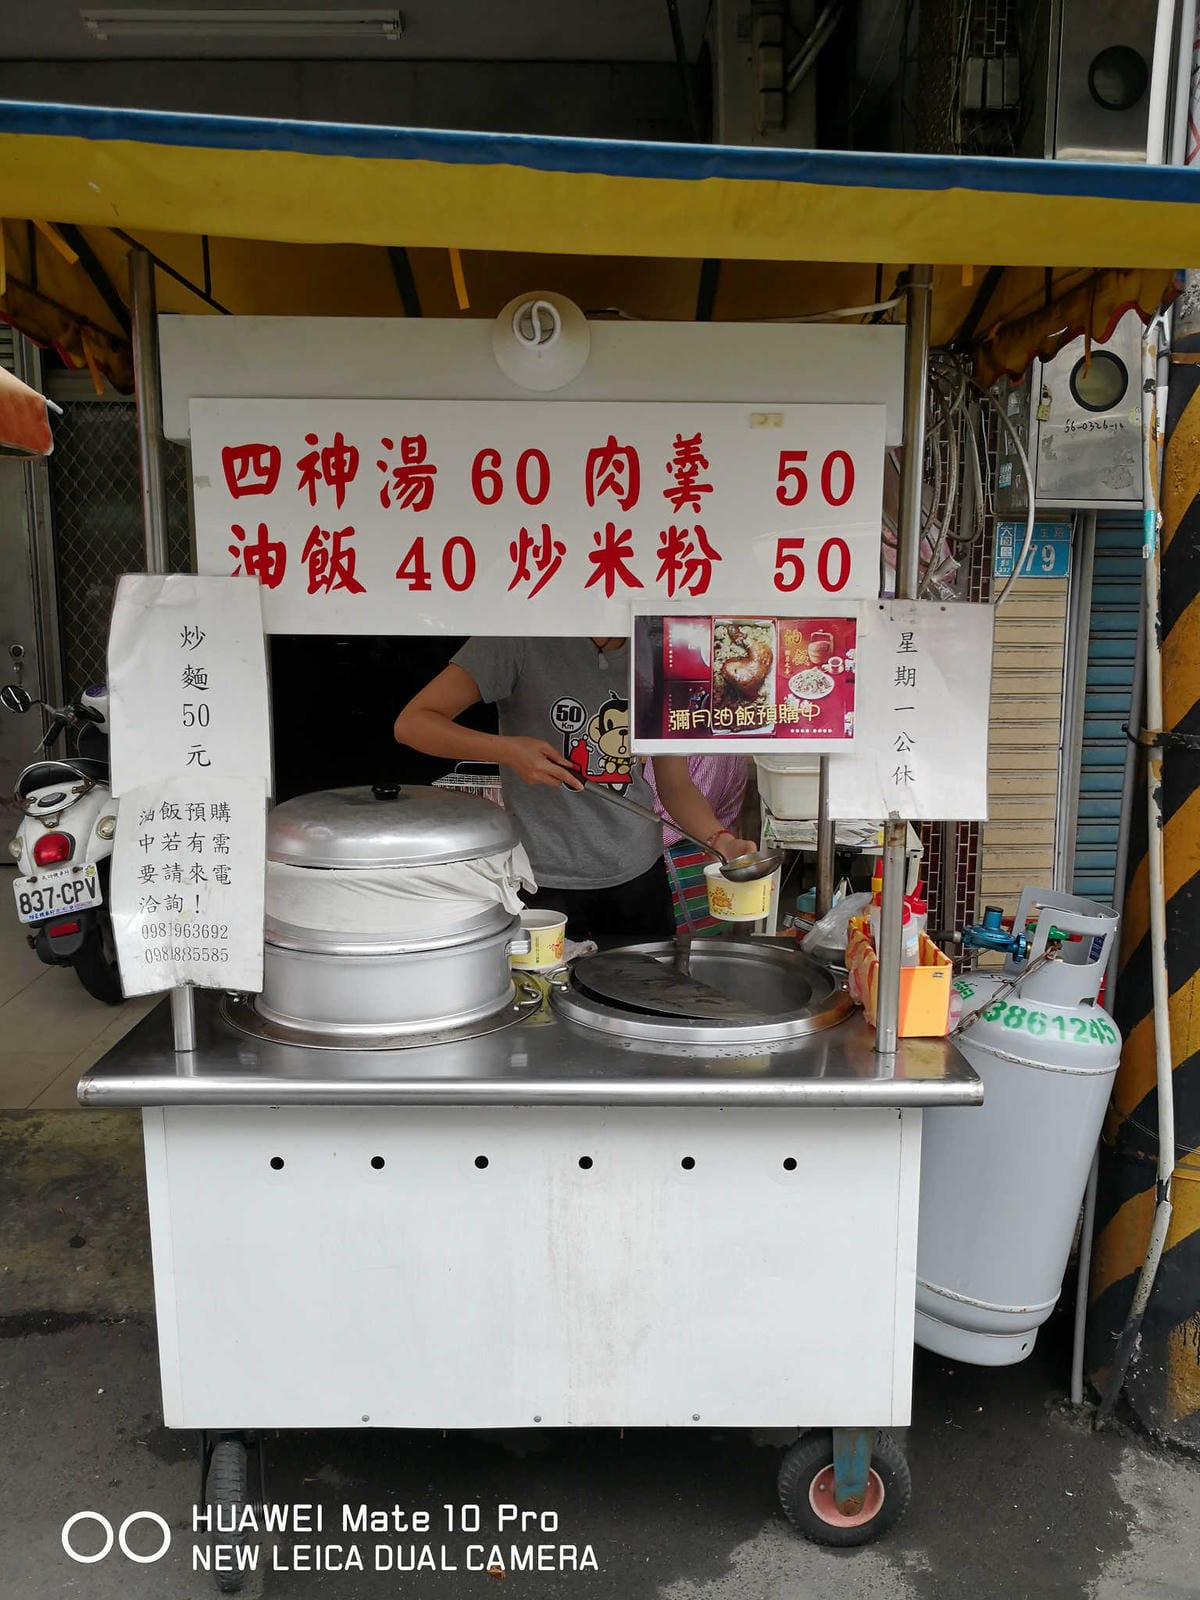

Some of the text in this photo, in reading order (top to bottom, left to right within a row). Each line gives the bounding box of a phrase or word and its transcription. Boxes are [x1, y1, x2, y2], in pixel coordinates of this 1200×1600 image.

[222, 432, 854, 513] 四神湯 60 肉羹 50
[228, 521, 851, 599] 油飯 40 炒米粉 50
[556, 706, 582, 722] 50
[891, 631, 918, 786] 星期一公休
[139, 801, 231, 826] 油飯預購
[139, 832, 231, 855] 中若有需
[138, 862, 232, 885] 要請來電
[141, 923, 229, 940] 0981963692
[981, 1000, 1118, 1046] 3861245
